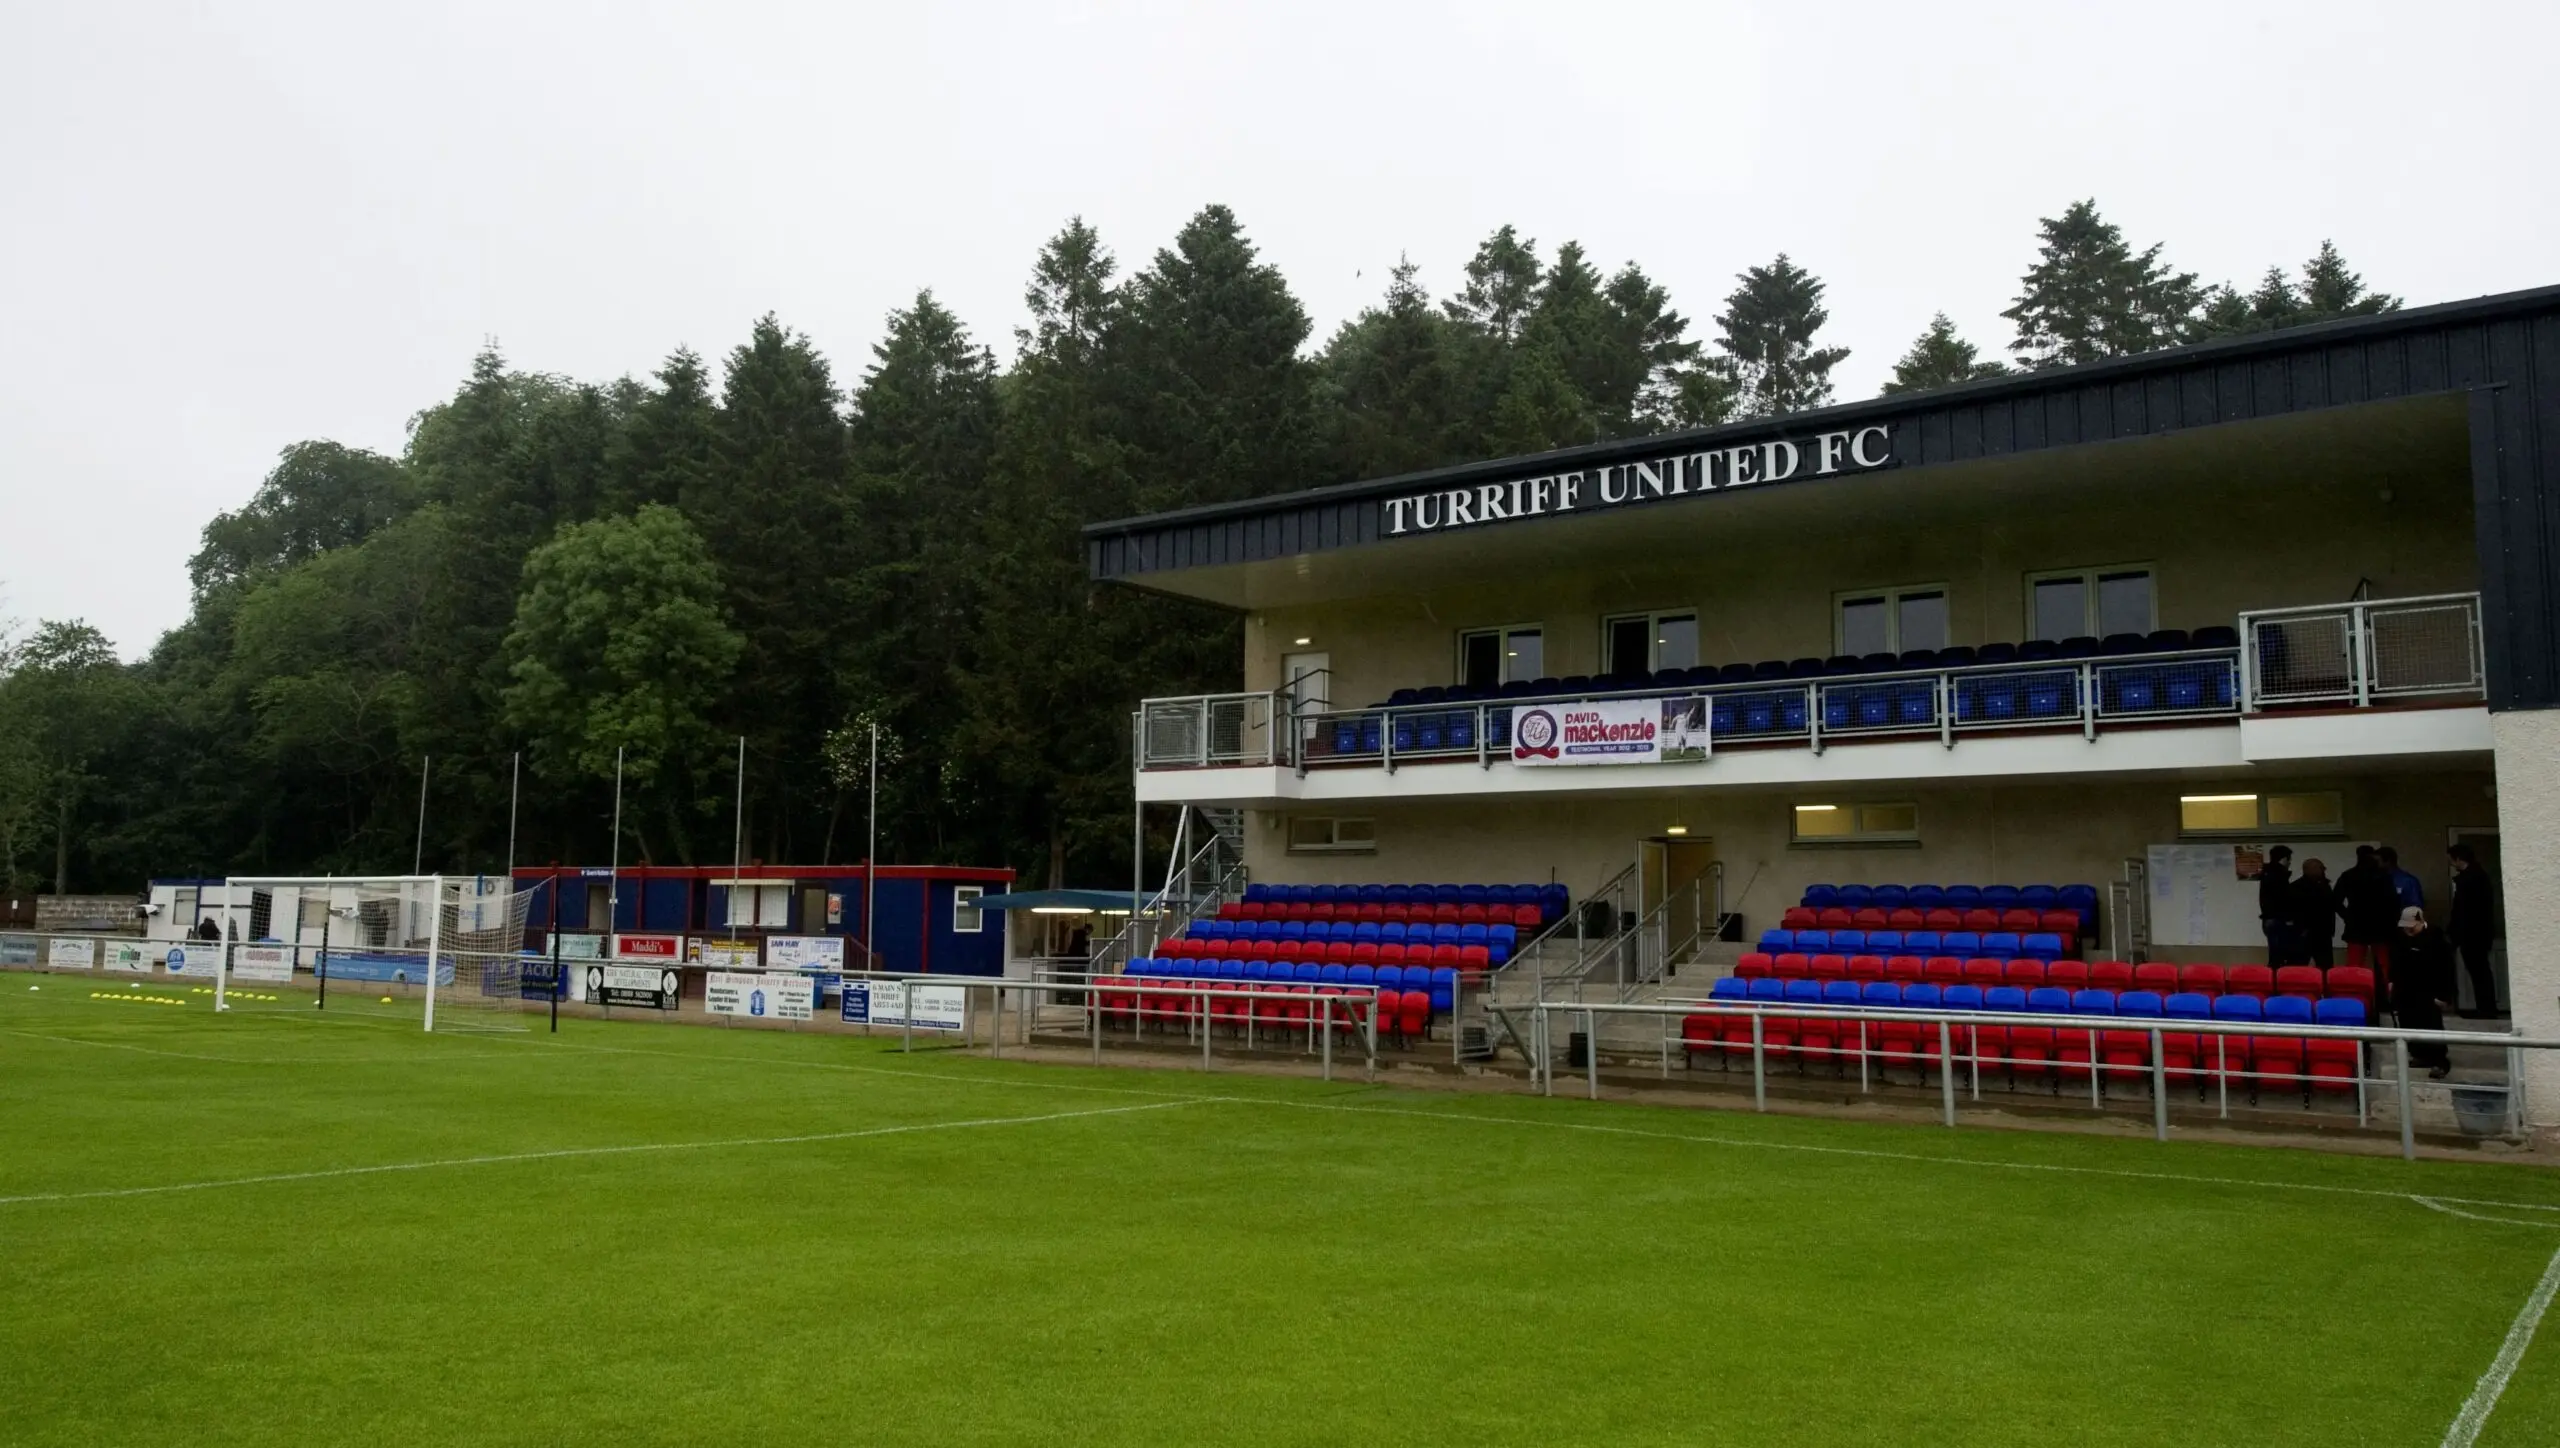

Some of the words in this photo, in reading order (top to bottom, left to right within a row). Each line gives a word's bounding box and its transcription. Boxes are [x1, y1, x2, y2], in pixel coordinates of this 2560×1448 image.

[1385, 471, 1584, 533] TURRIFF
[1595, 440, 1799, 503] UNITED
[1814, 425, 1890, 473] FC
[1565, 712, 1599, 724] DAVID
[1564, 717, 1655, 743] mackenzie
[631, 940, 664, 952] Maddi's
[588, 989, 600, 999] kirk
[877, 984, 895, 992] MAIN
[896, 984, 922, 993] STET
[662, 994, 676, 1004] kirk
[872, 992, 900, 1001] TURRIFF
